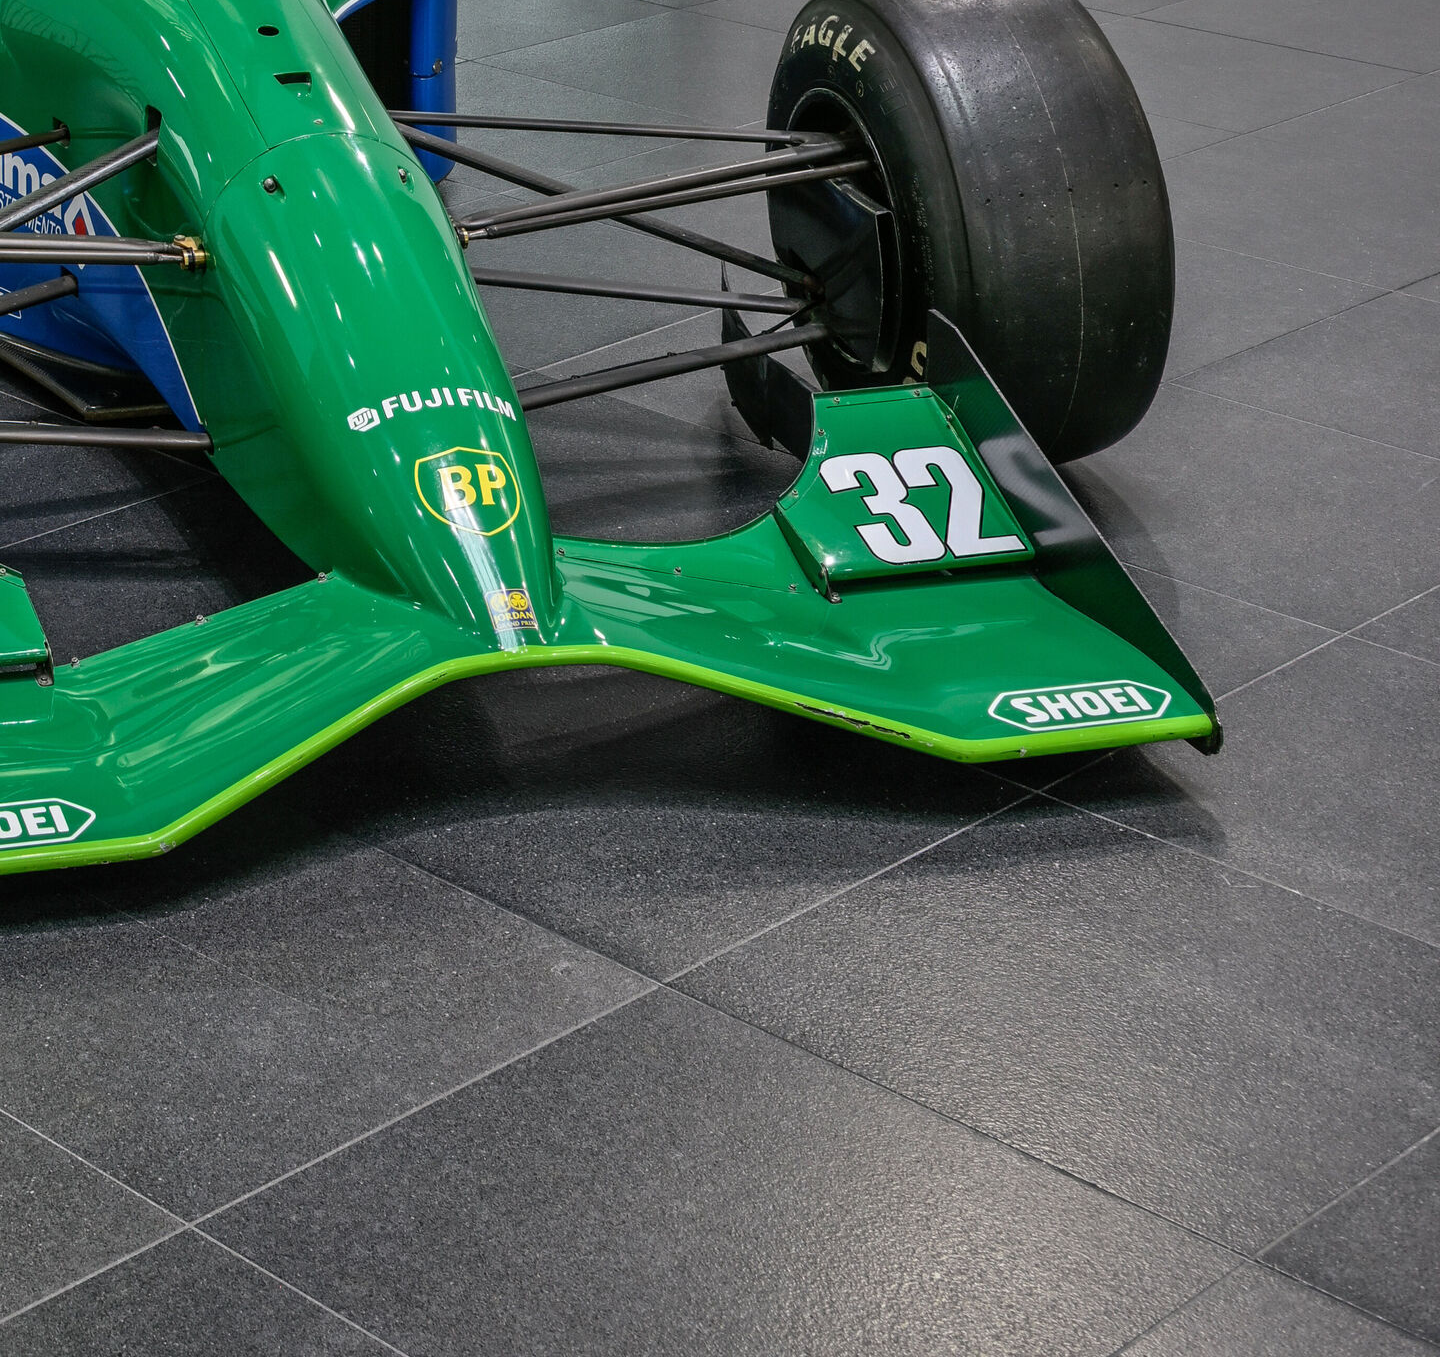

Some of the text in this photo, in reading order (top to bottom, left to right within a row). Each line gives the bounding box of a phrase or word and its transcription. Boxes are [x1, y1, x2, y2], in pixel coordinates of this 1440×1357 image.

[790, 15, 877, 73] EAGLE
[437, 464, 506, 512] BP
[817, 445, 1029, 565] 32
[1008, 685, 1153, 725] SHOEI
